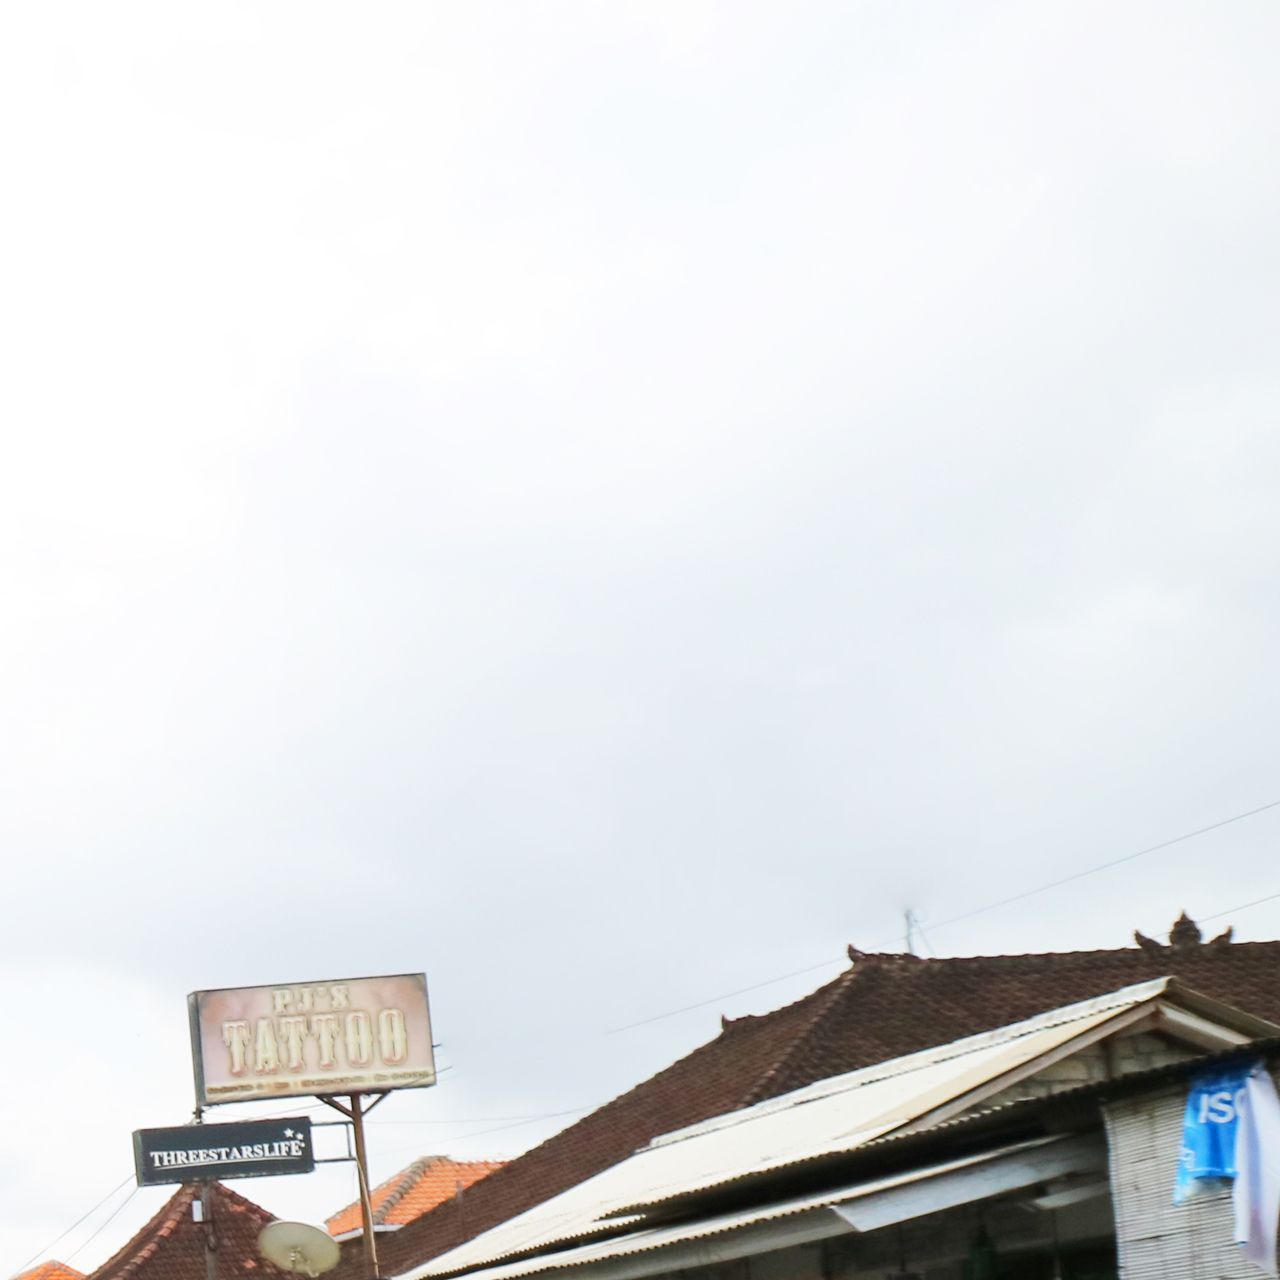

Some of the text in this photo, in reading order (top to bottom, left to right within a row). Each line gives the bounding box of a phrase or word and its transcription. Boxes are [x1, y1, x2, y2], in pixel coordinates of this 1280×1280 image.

[272, 984, 351, 1014] PJ'S
[221, 1008, 409, 1078] TATTOO
[149, 1139, 304, 1168] THREESTARSLIFE
